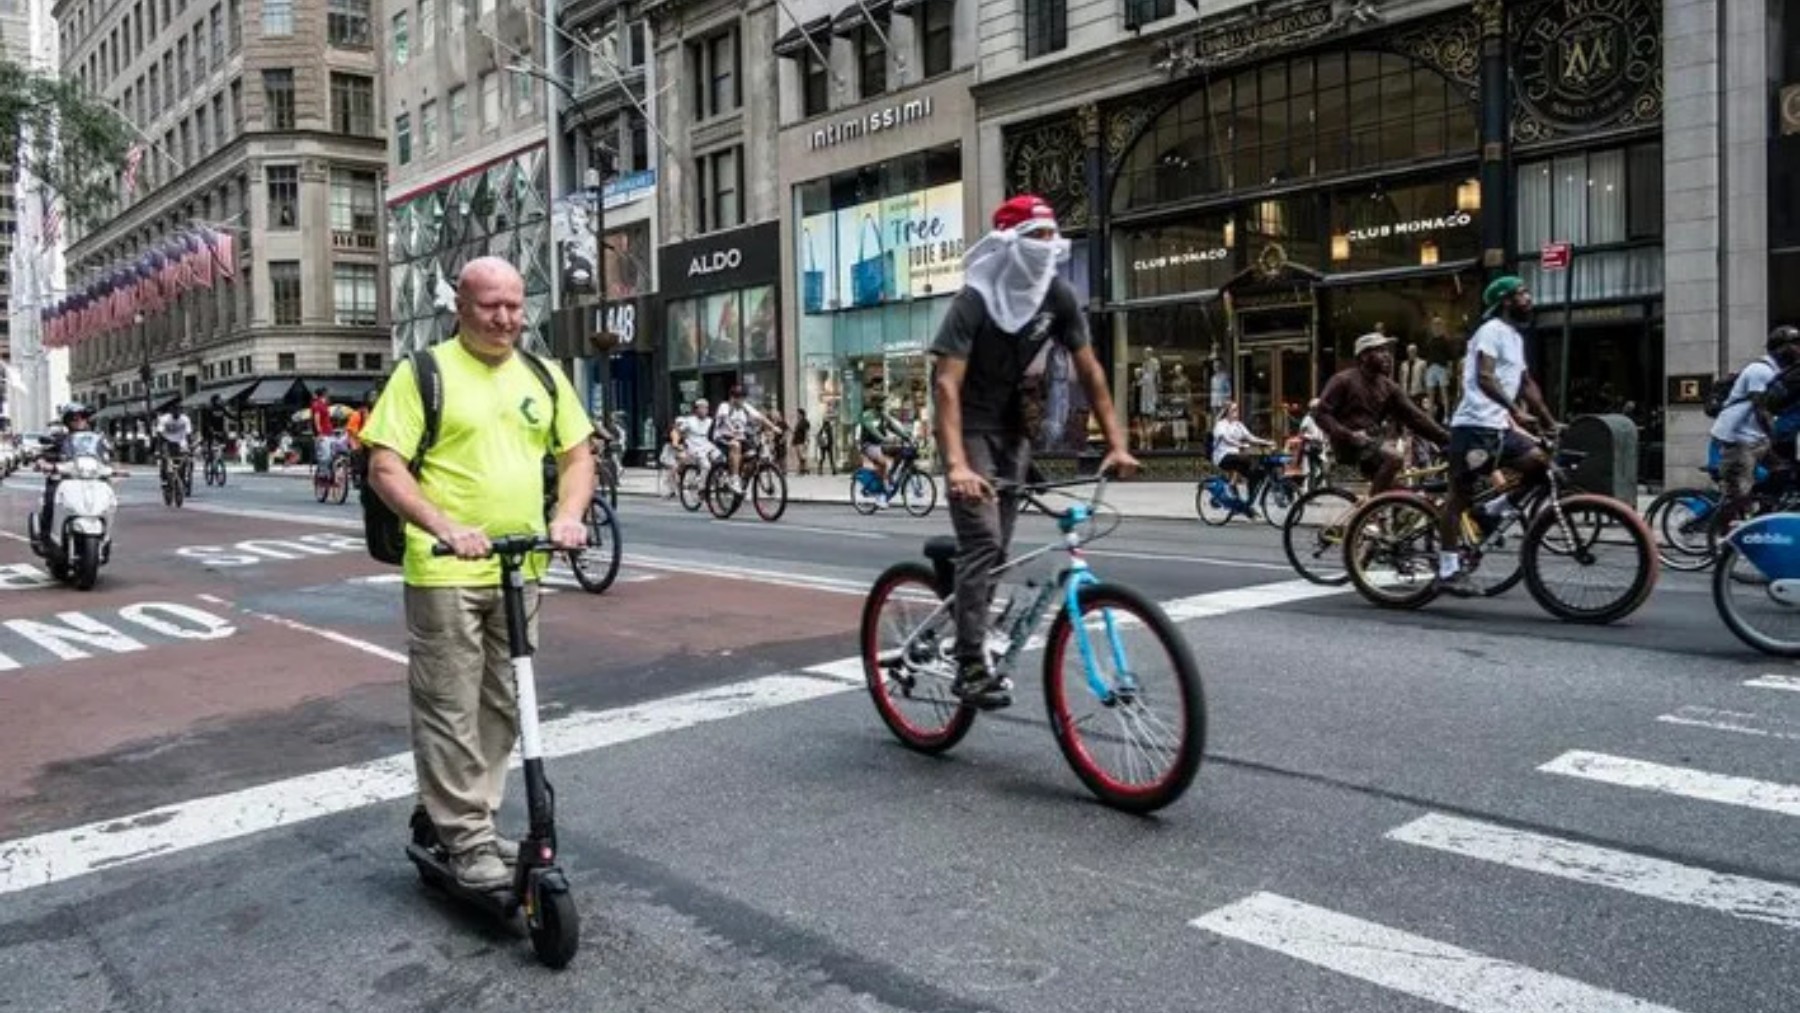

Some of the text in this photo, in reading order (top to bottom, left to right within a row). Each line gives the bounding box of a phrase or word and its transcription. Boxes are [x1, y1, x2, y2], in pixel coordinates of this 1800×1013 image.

[1345, 213, 1471, 241] CLUB MONACO
[688, 248, 742, 277] ALDO
[1134, 248, 1227, 270] CLUB MONACO
[0, 602, 236, 671] ON
